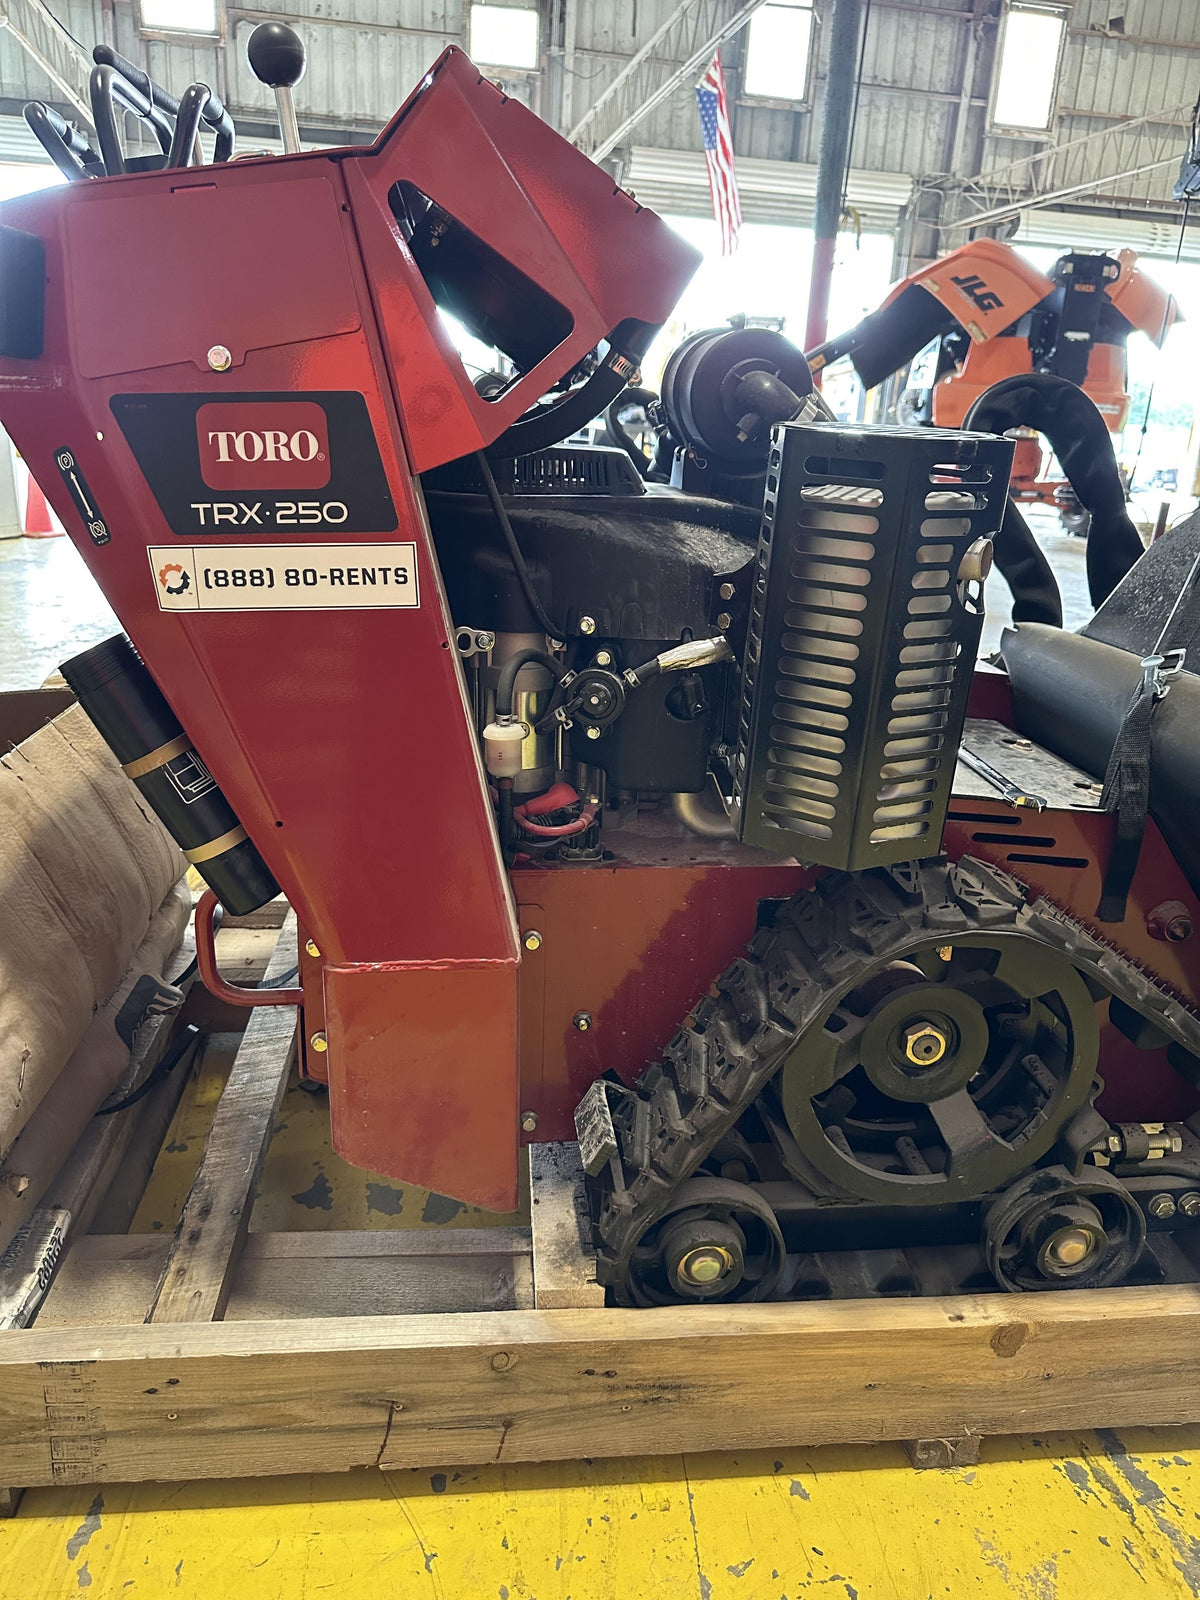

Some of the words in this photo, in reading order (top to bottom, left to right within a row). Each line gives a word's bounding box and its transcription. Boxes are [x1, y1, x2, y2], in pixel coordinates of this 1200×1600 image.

[950, 275, 1004, 313] JLG
[208, 430, 320, 462] TORO
[204, 568, 275, 589] (888)
[285, 566, 409, 587] 80-RENTS
